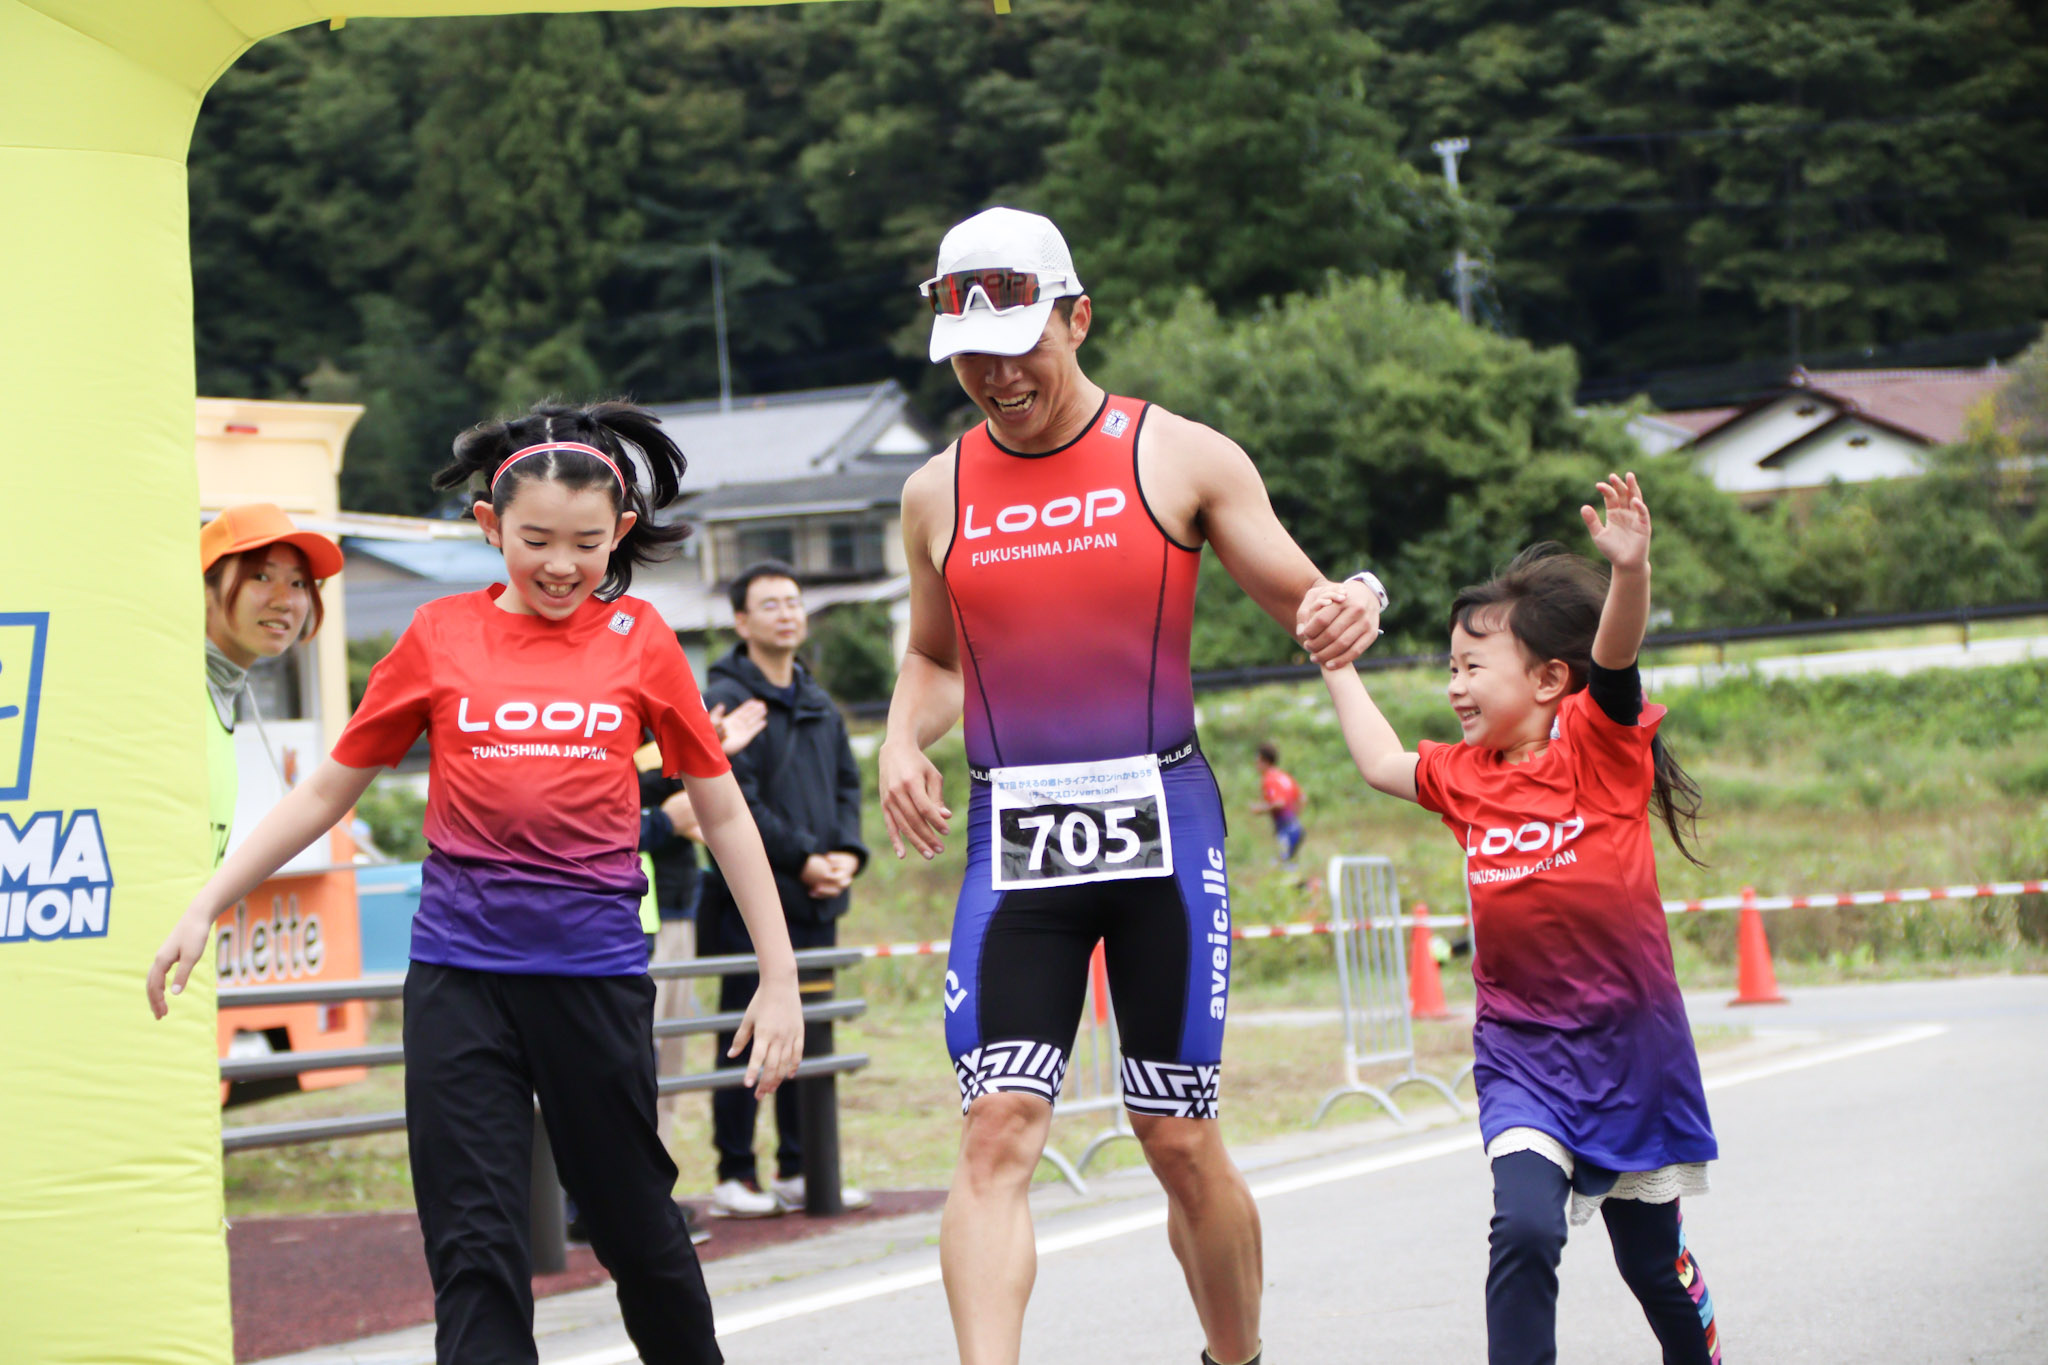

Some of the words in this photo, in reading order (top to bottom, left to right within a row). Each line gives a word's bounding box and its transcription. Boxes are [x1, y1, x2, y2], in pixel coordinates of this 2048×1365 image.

[963, 488, 1126, 540] LOOP
[971, 541, 1063, 567] FUKUSHIMA
[1066, 533, 1118, 553] JAPAN
[457, 697, 622, 738] LOOP
[472, 744, 560, 760] FUKUSHIMA
[563, 745, 607, 761] JAPAN
[1158, 744, 1192, 767] HUUB
[1018, 806, 1141, 871] 705
[1467, 816, 1584, 857] LOOP
[0, 887, 107, 937] ION
[1201, 847, 1229, 1021] aveic.llc
